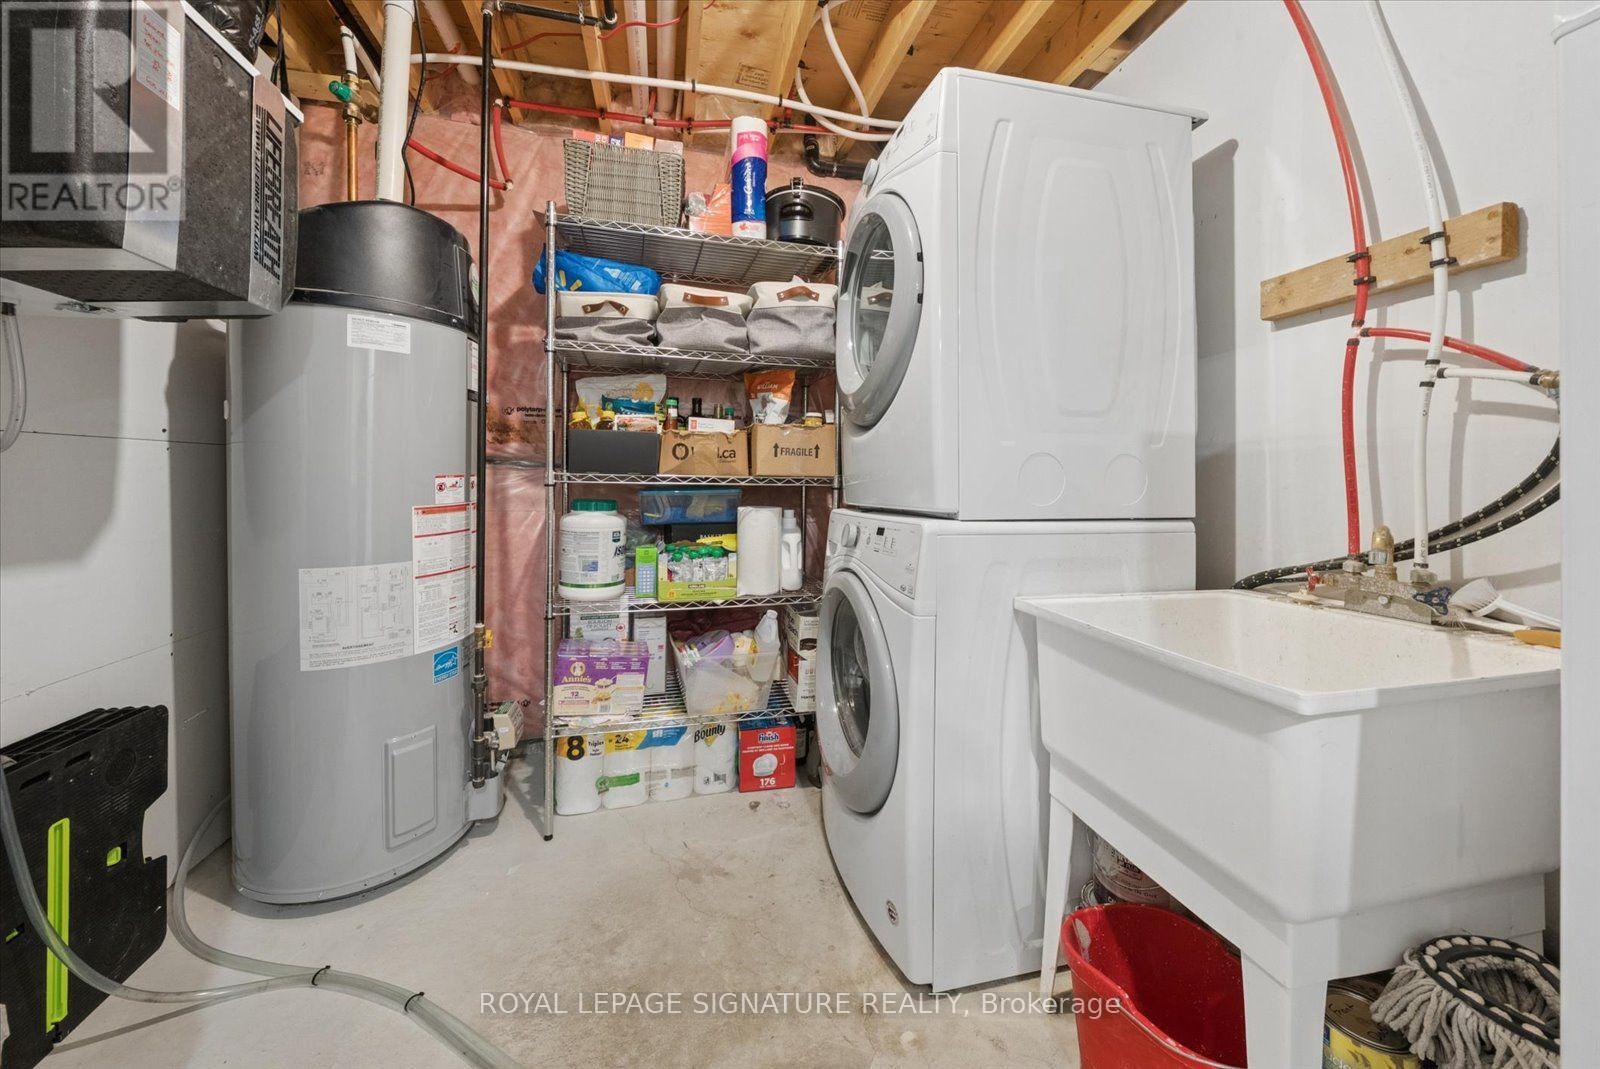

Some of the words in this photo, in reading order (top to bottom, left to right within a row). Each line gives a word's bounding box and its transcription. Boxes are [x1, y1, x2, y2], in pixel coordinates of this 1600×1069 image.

[264, 110, 283, 280] LIFEBREATH
[780, 446, 813, 457] FRAGILE
[562, 675, 592, 683] Annie's
[694, 723, 726, 743] Bounty
[566, 735, 585, 761] 8
[760, 777, 776, 787] 176
